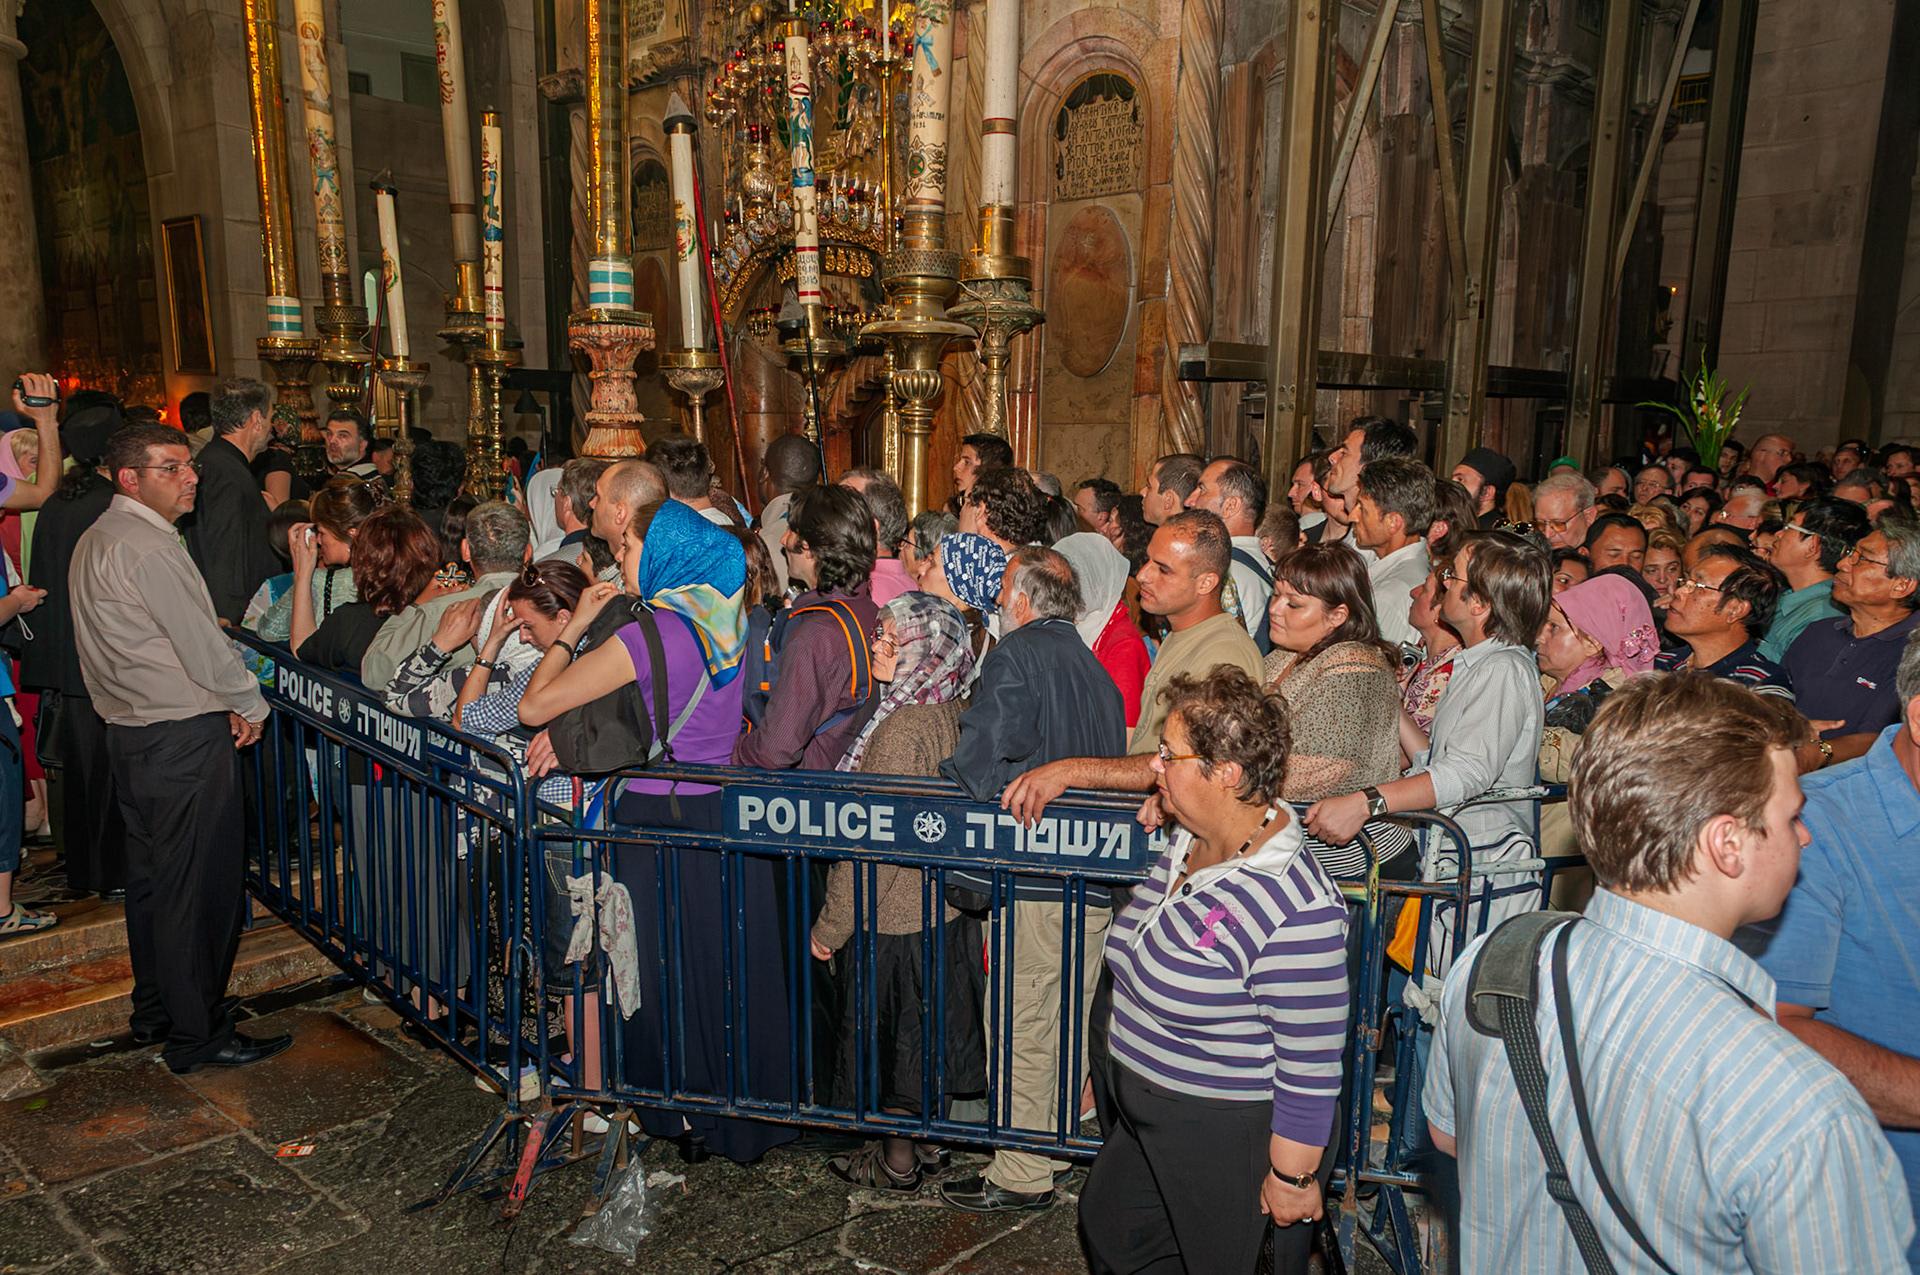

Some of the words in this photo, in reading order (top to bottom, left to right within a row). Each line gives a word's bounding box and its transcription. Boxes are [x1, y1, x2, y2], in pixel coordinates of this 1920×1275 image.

[278, 665, 333, 719] POLICE
[356, 702, 422, 761] משטרה
[737, 794, 896, 843] POLICE
[964, 811, 1132, 861] משטרה
